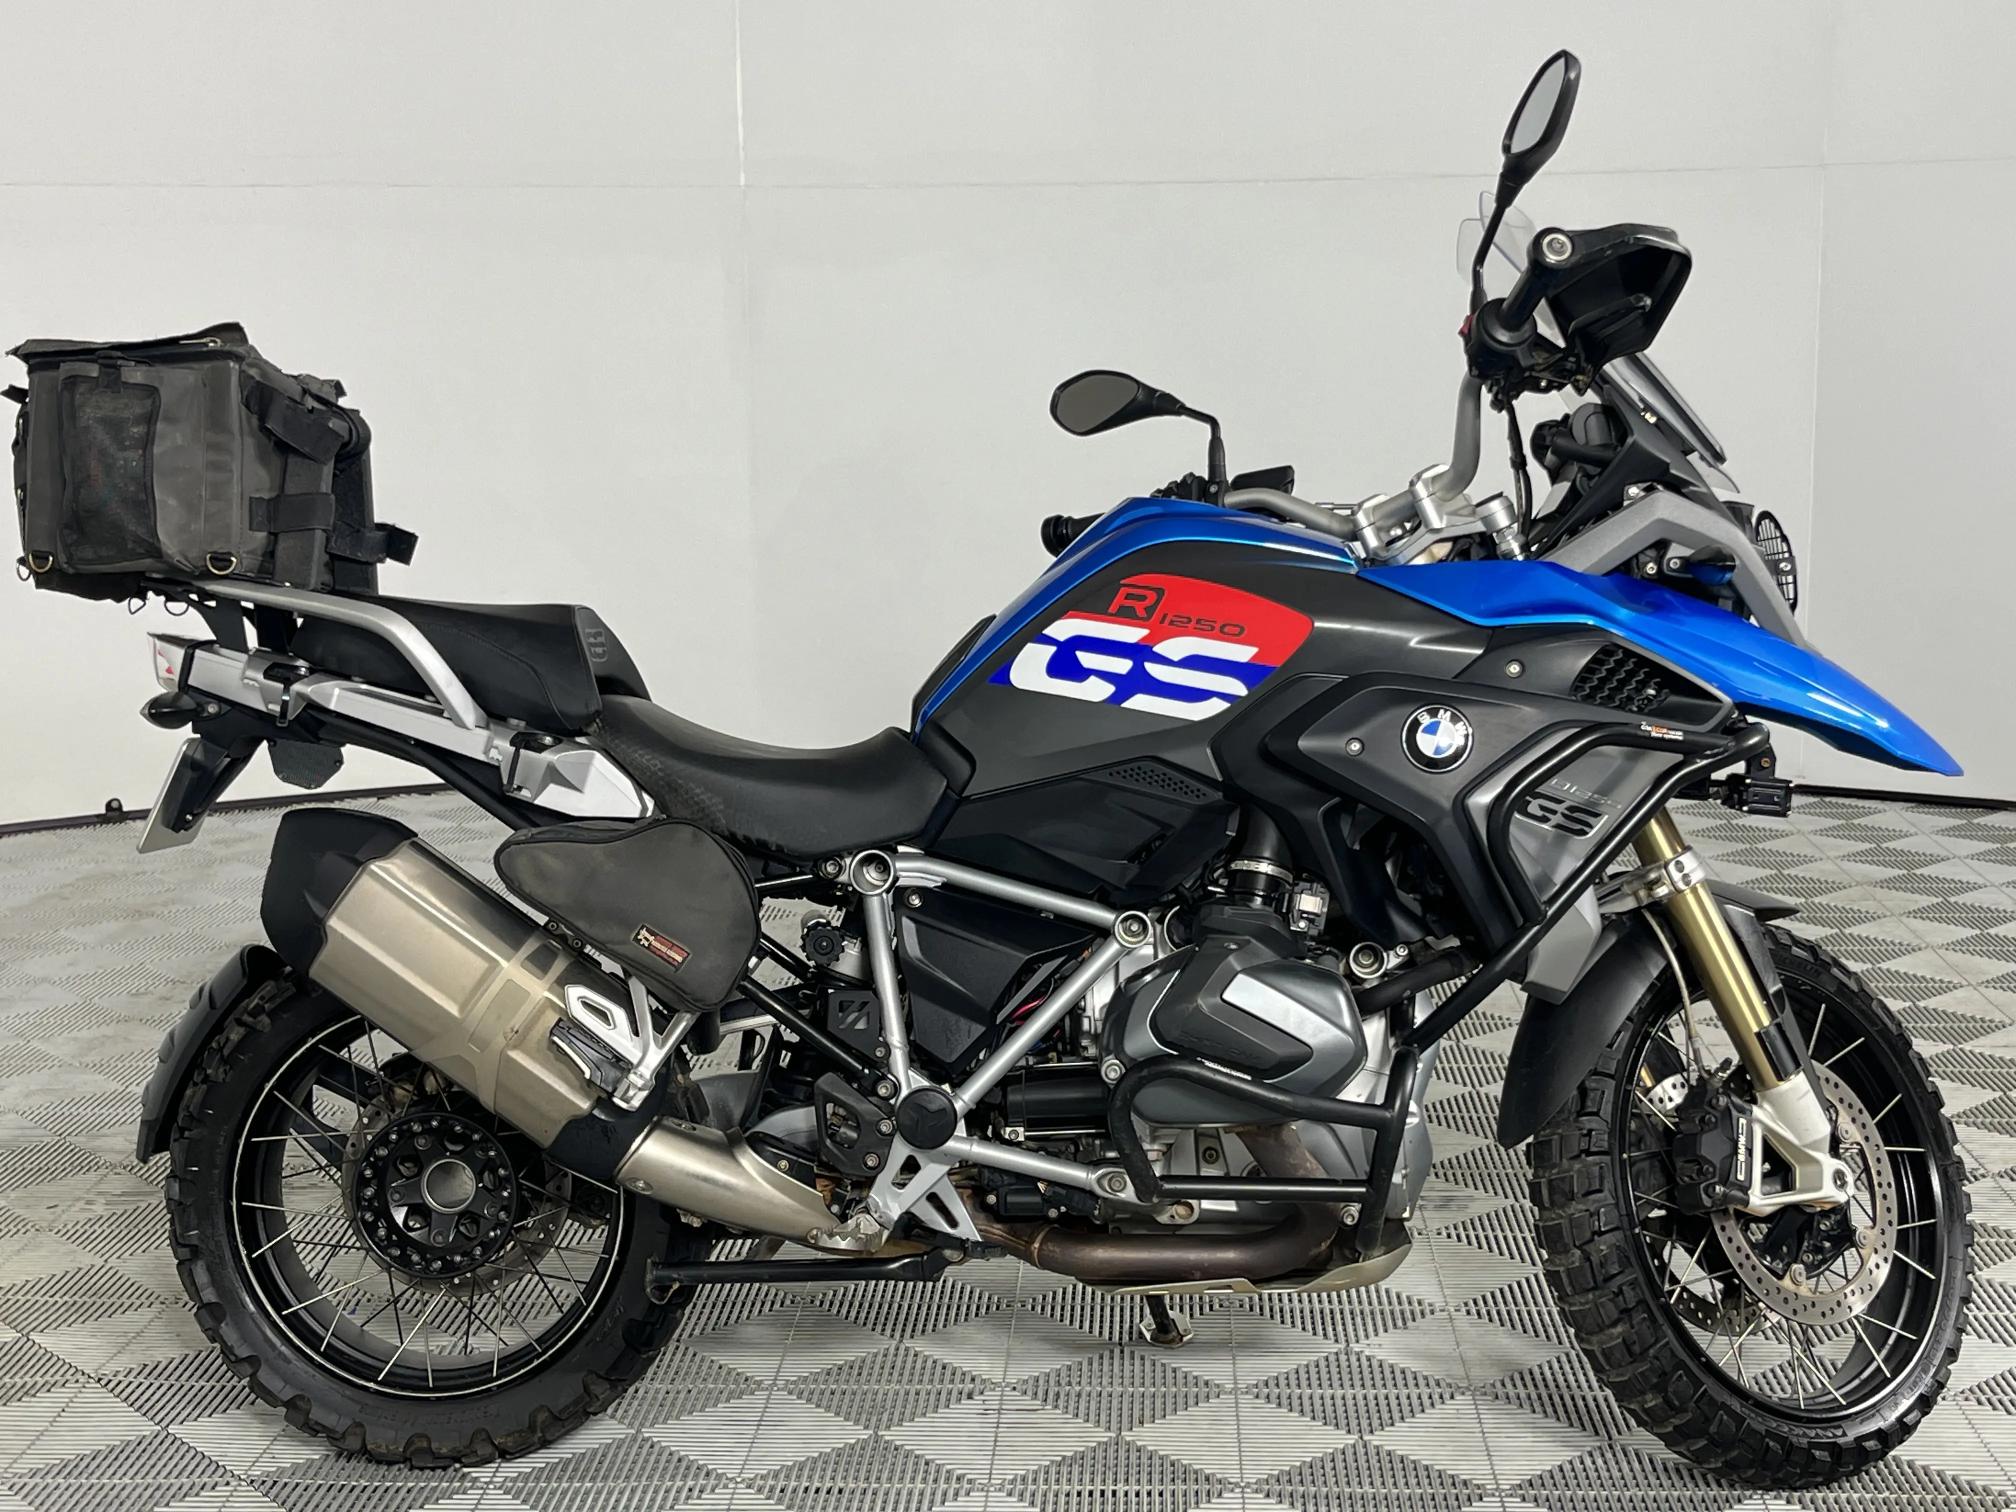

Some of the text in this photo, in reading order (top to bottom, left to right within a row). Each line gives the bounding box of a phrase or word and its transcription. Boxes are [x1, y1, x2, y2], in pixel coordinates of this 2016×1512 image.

[1107, 586, 1246, 637] R 1250
[1009, 619, 1259, 721] GS
[1417, 709, 1468, 746] BMW
[1516, 791, 1602, 836] GS
